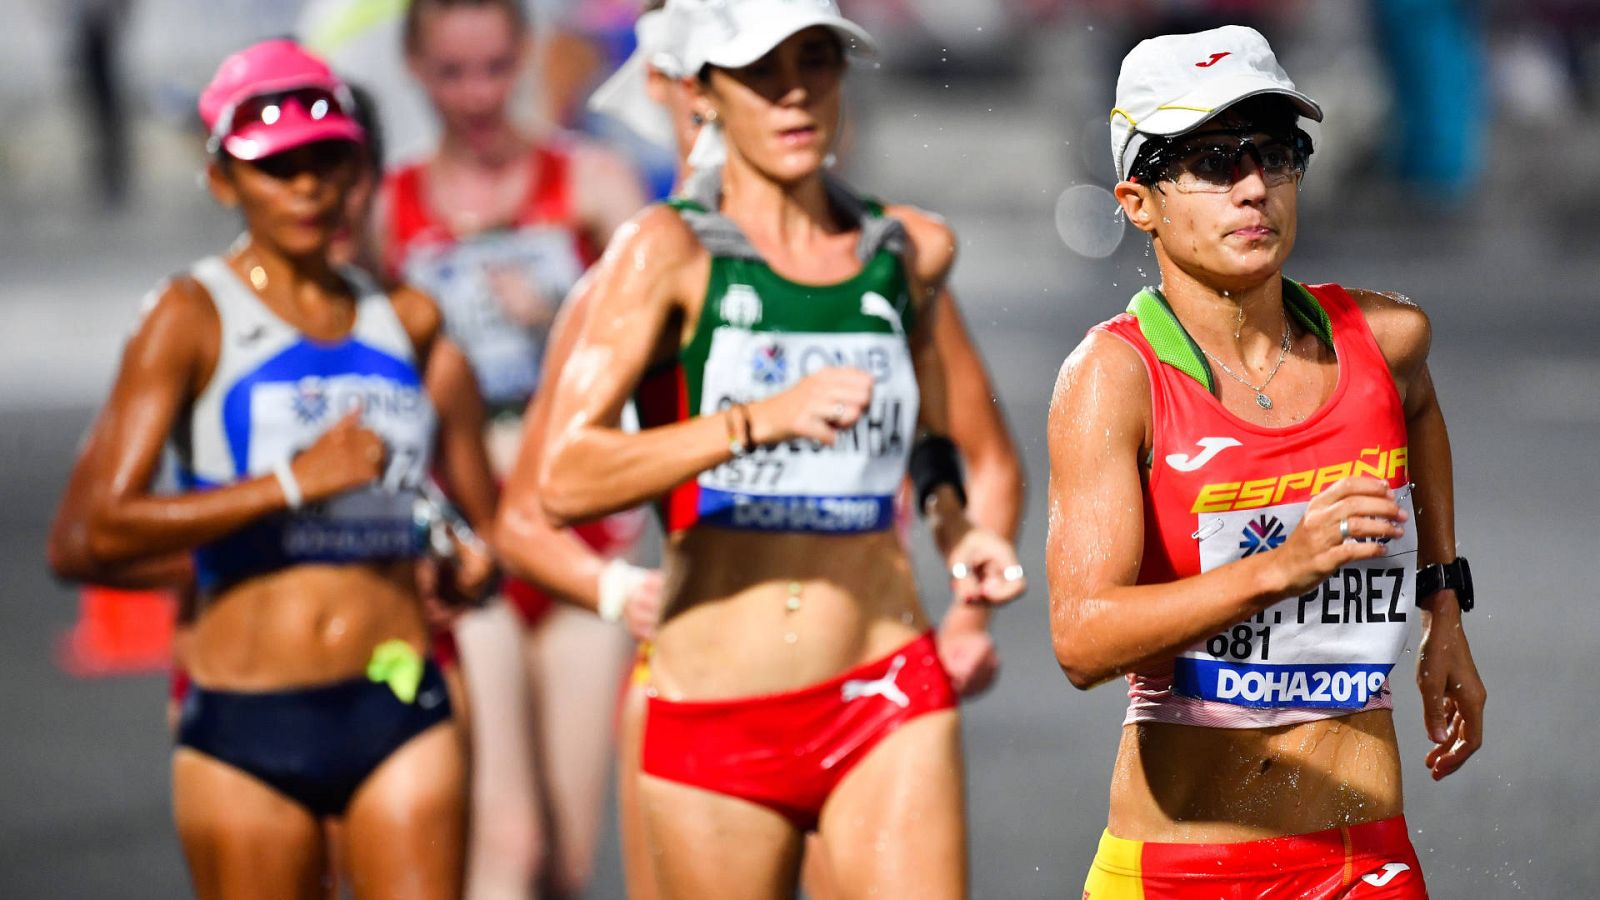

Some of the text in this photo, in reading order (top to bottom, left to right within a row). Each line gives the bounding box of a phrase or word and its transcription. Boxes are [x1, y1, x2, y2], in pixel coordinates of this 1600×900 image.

[1190, 444, 1408, 513] ESPAÑA
[1296, 567, 1407, 624] PEREZ
[1206, 624, 1271, 660] 681
[1216, 668, 1387, 702] DOHA2019
